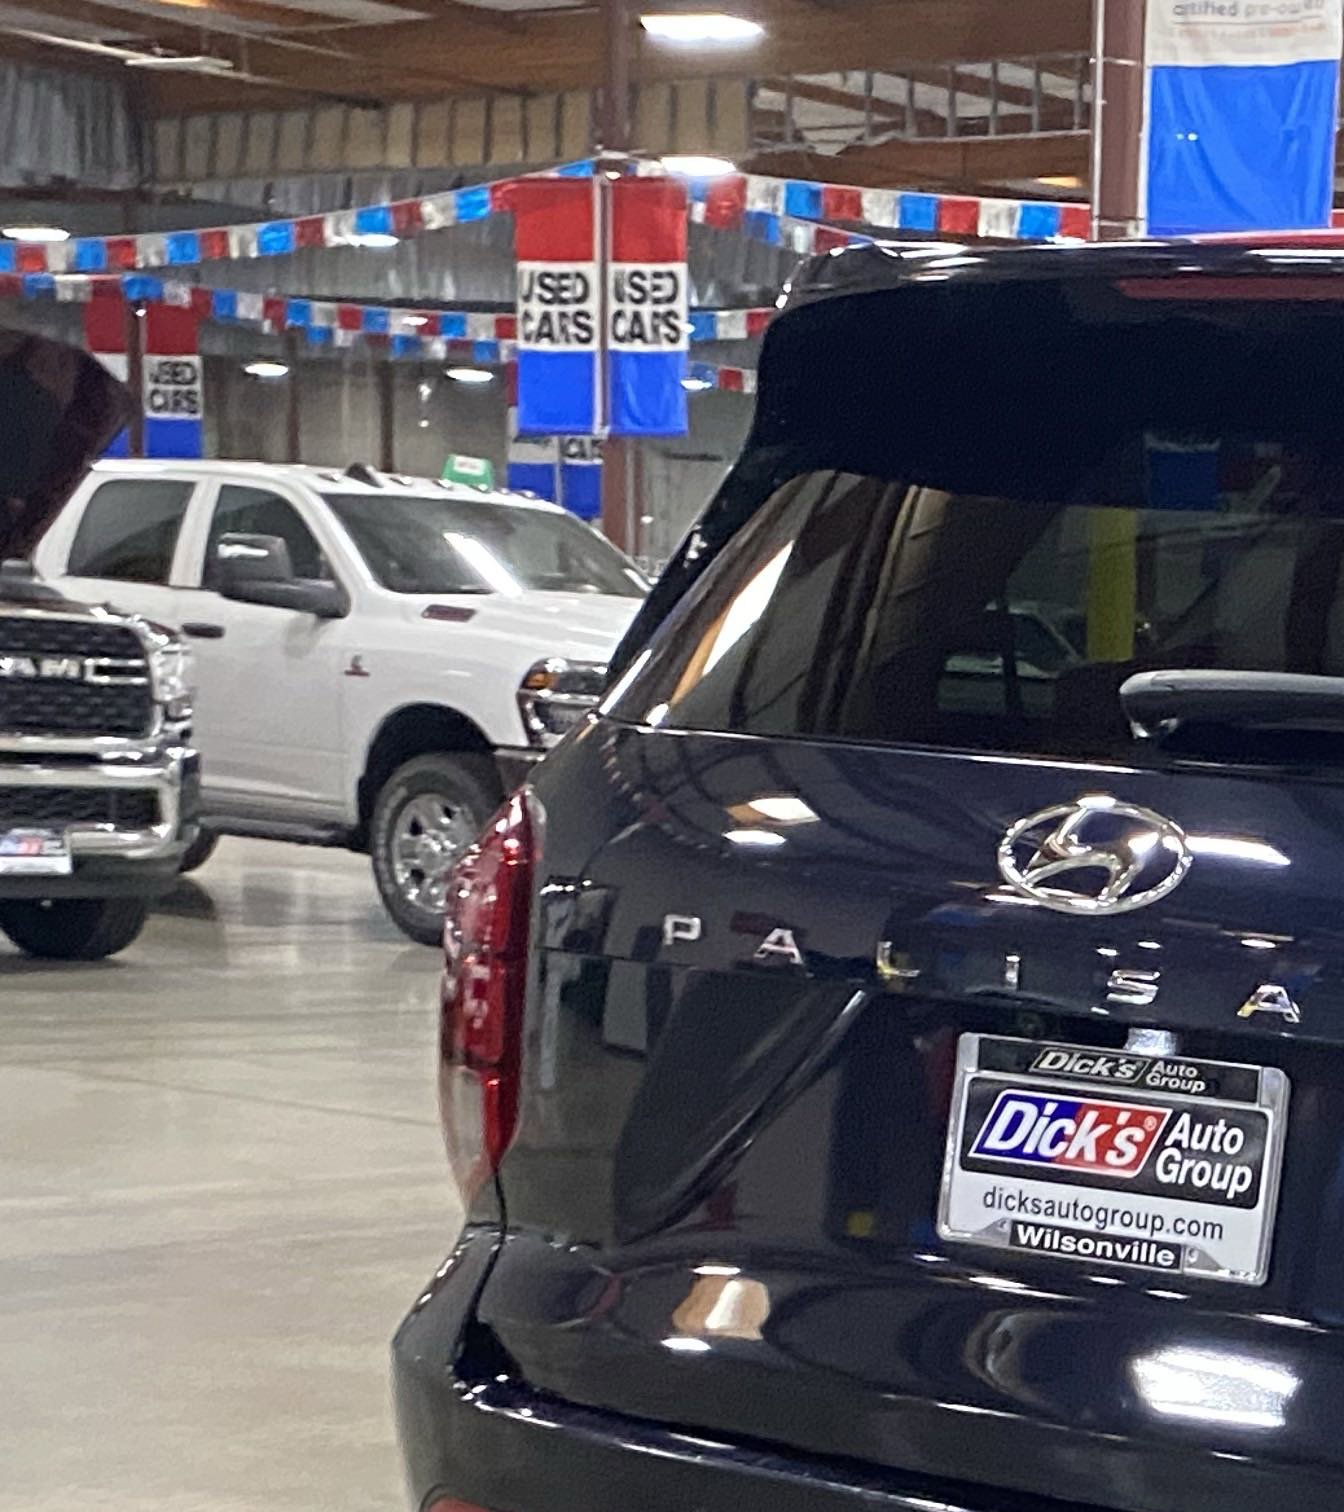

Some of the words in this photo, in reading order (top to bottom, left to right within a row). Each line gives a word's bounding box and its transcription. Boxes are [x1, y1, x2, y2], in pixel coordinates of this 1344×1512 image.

[1038, 1051, 1140, 1080] Dick's
[1151, 1060, 1199, 1078] Auto
[1146, 1073, 1206, 1094] Group
[982, 1100, 1148, 1168] Dick's
[1164, 1112, 1244, 1155] Auto
[1156, 1148, 1252, 1199] Group
[983, 1186, 1224, 1240] dicksautogroup.com
[1016, 1223, 1175, 1267] Wilsonville
